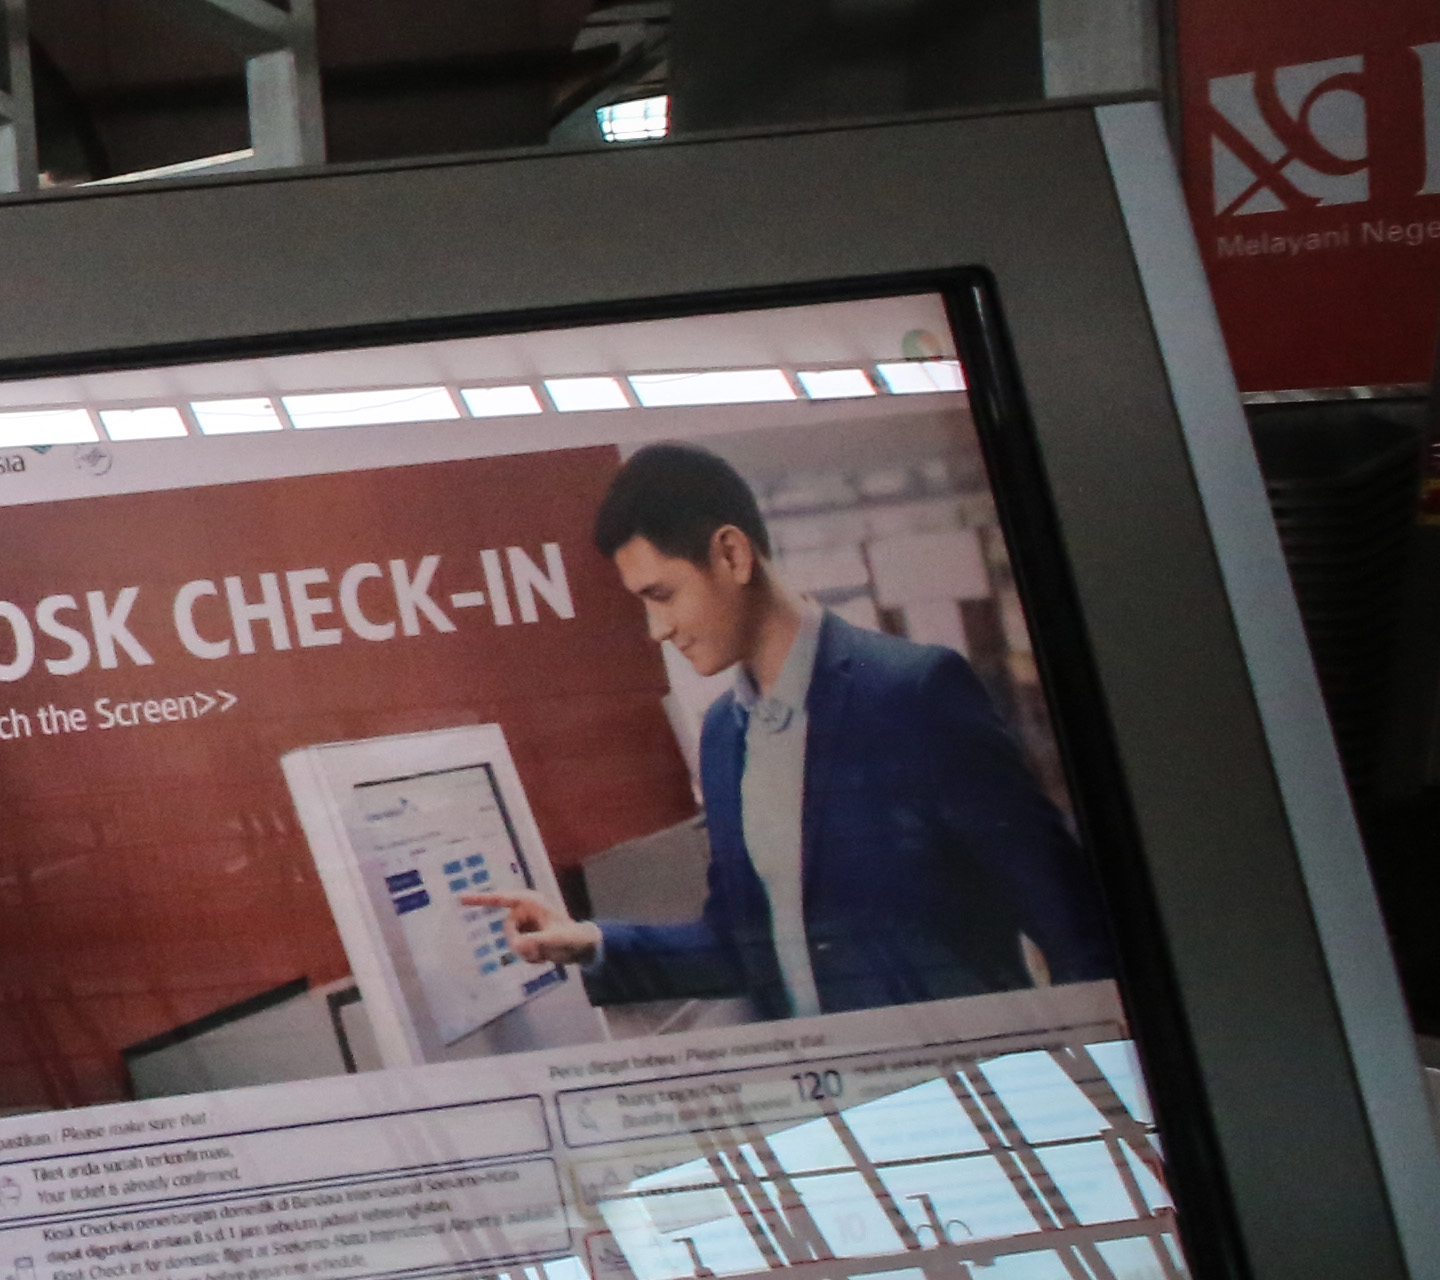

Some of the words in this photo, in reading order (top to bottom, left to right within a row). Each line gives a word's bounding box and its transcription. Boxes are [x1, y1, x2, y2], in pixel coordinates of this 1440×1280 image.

[1216, 223, 1349, 258] Melayani
[172, 542, 576, 660] CHECK-IN
[38, 700, 87, 736] the
[791, 1070, 843, 1102] 120
[61, 1126, 105, 1141] Please
[121, 1175, 172, 1193] already
